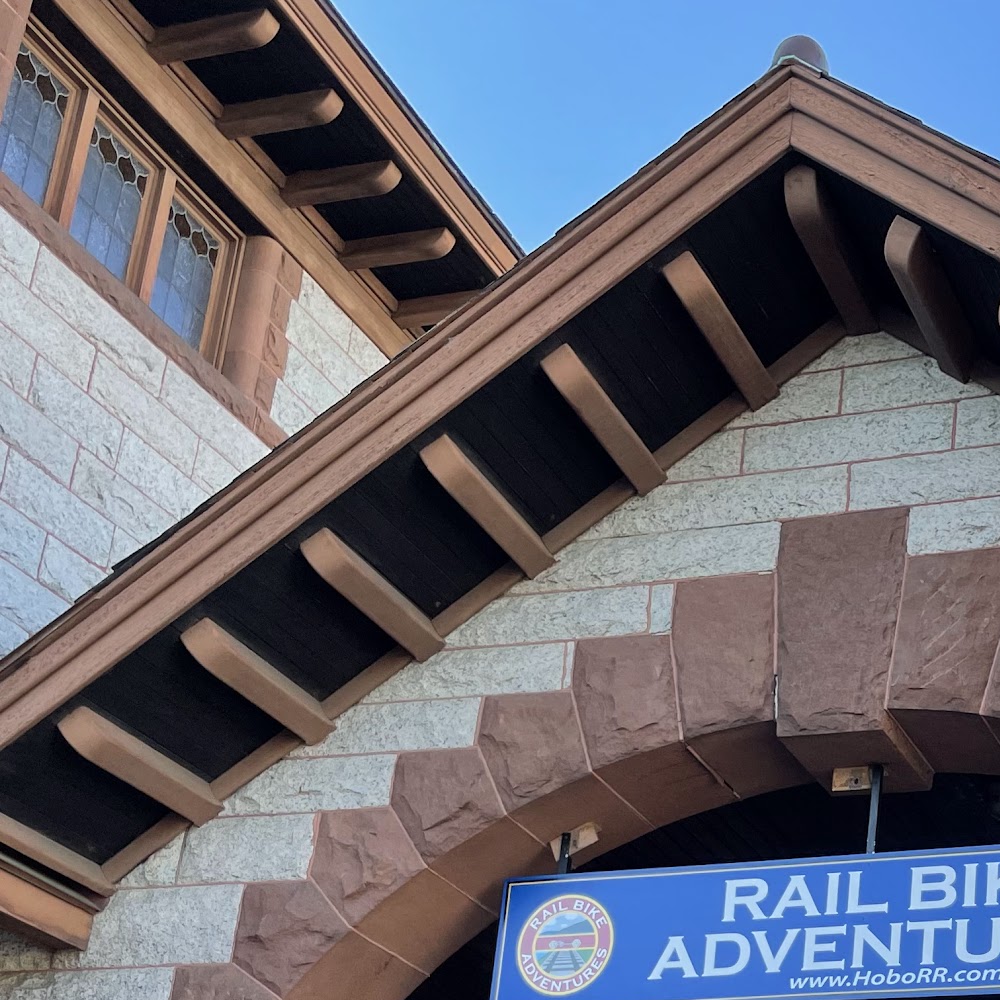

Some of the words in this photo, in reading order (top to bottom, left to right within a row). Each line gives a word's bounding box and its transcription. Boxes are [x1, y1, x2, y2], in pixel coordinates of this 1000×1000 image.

[530, 901, 568, 930] RAIL
[573, 899, 608, 929] BIKE
[721, 870, 889, 922] RAIL
[521, 947, 608, 992] ADVENTURES
